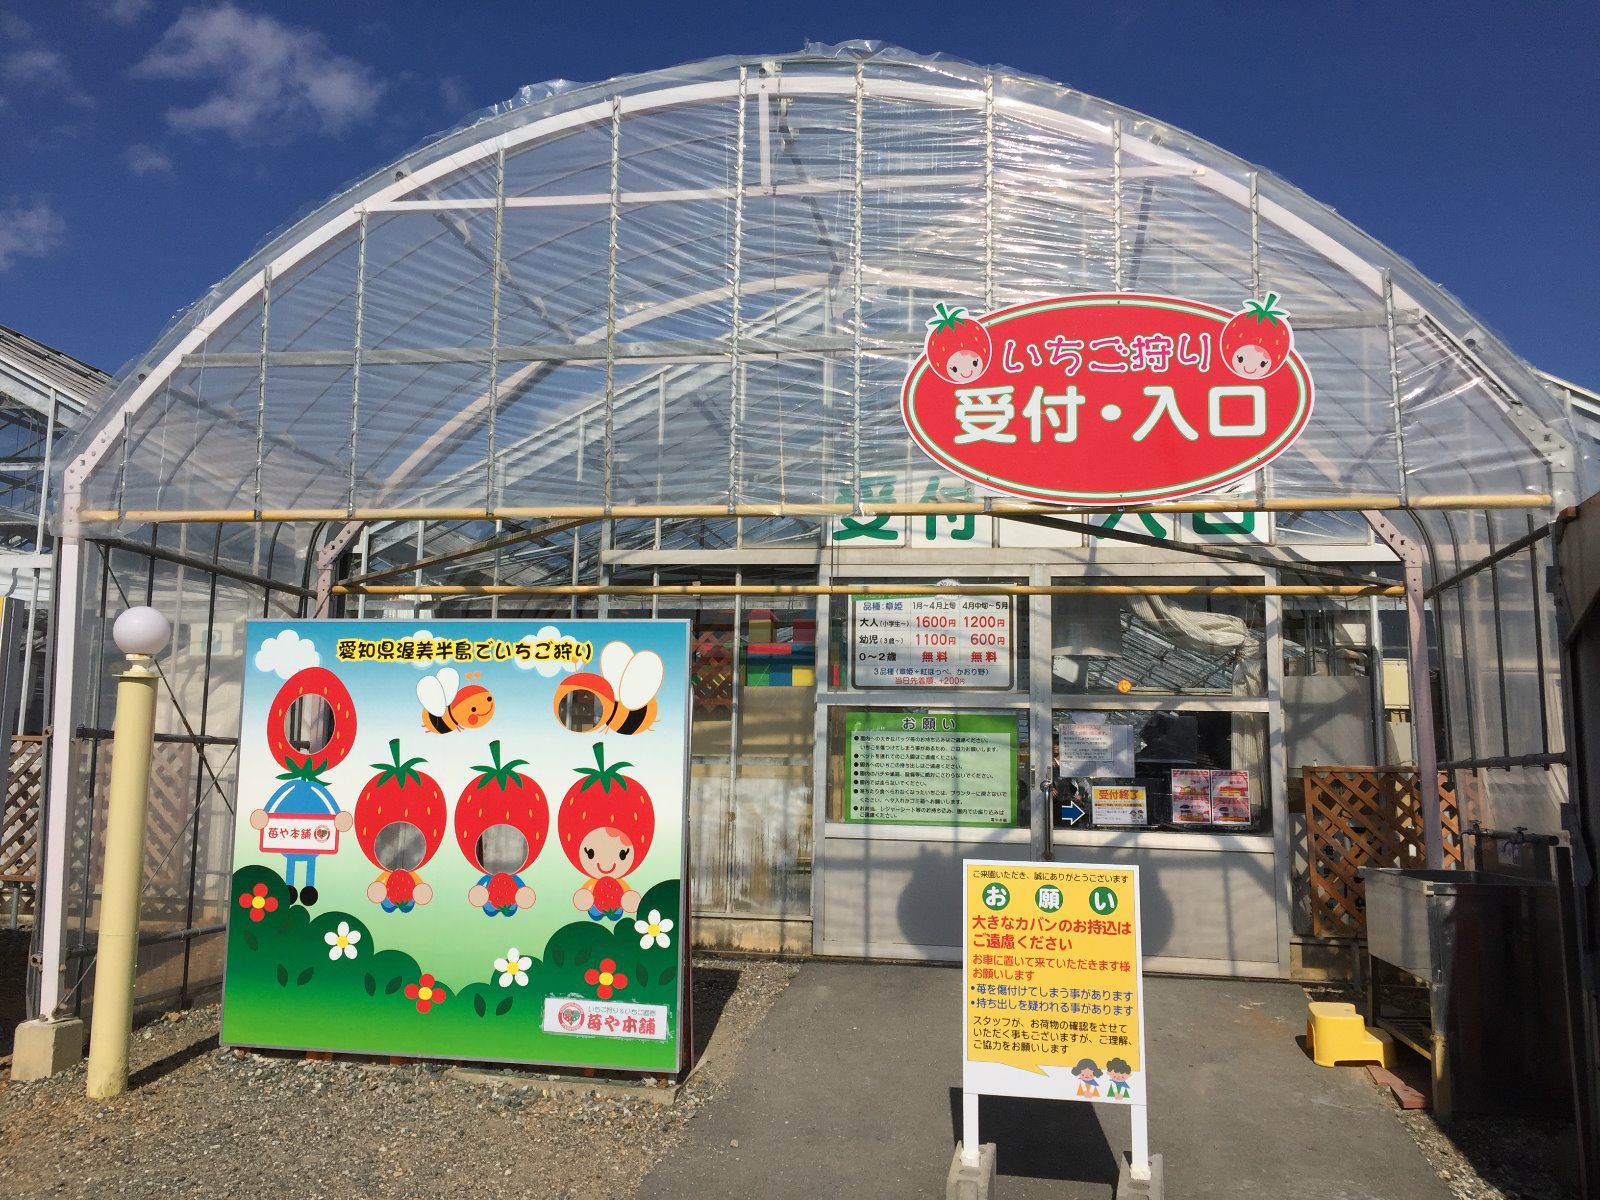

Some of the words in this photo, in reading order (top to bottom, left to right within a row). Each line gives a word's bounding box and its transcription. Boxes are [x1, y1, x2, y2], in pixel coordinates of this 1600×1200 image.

[1003, 333, 1212, 375] いちご狩り
[954, 385, 1268, 444] 受付・入口
[916, 616, 956, 628] 1600円
[964, 616, 1005, 628] 1200円
[915, 634, 956, 646] 1100円
[970, 633, 1005, 646] 600円
[338, 639, 592, 661] 愛知県渥美半島でいちご狩り
[922, 651, 948, 662] 無料
[970, 651, 998, 662] 無料
[902, 717, 956, 731] お願い
[972, 914, 1132, 936] 大きなカバンのお持込は
[973, 934, 1072, 951] ご遠慮ください
[972, 954, 1131, 972] お車に置いて来ていただきます様
[972, 968, 1035, 980] お願いします
[973, 1016, 1128, 1034] スタッフが、お荷物の確認をさせて
[973, 1040, 1069, 1054] ご協力をお願いします
